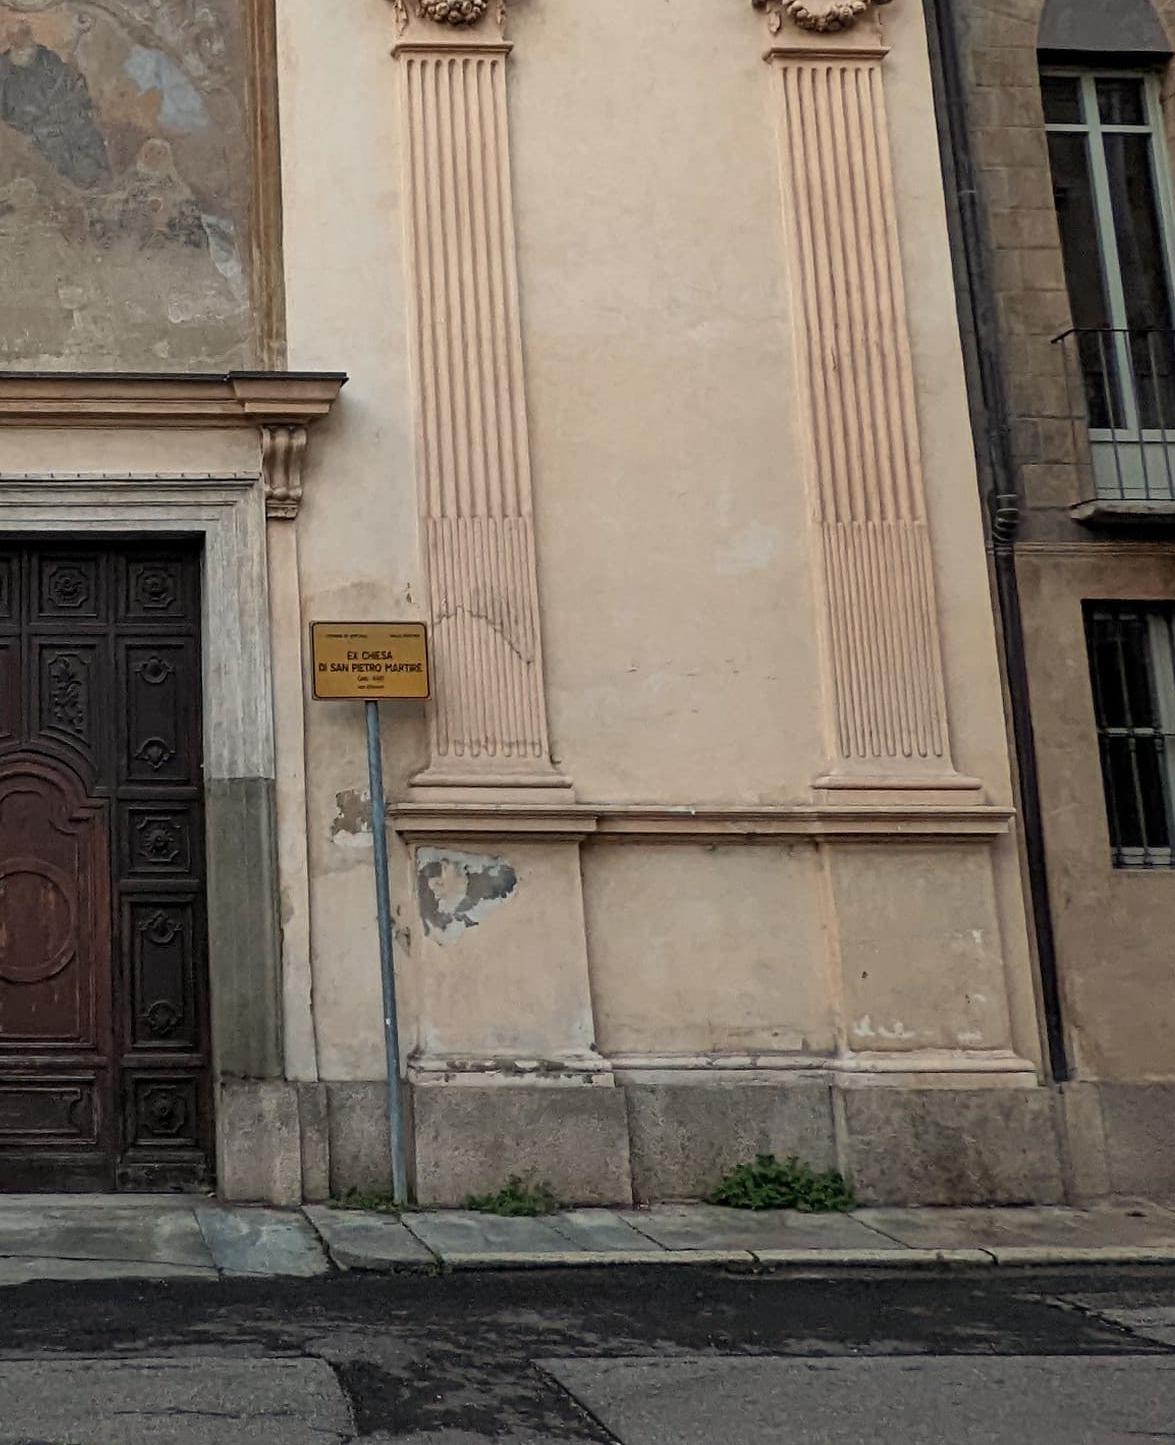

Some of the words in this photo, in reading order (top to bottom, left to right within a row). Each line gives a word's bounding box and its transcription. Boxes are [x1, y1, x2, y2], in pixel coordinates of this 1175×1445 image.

[347, 650, 358, 660] EX
[361, 650, 393, 660] CHIESA
[318, 663, 328, 672] DI
[330, 663, 349, 672] SAN
[351, 663, 382, 672] PIETRO
[384, 663, 423, 672] MARTIRE
